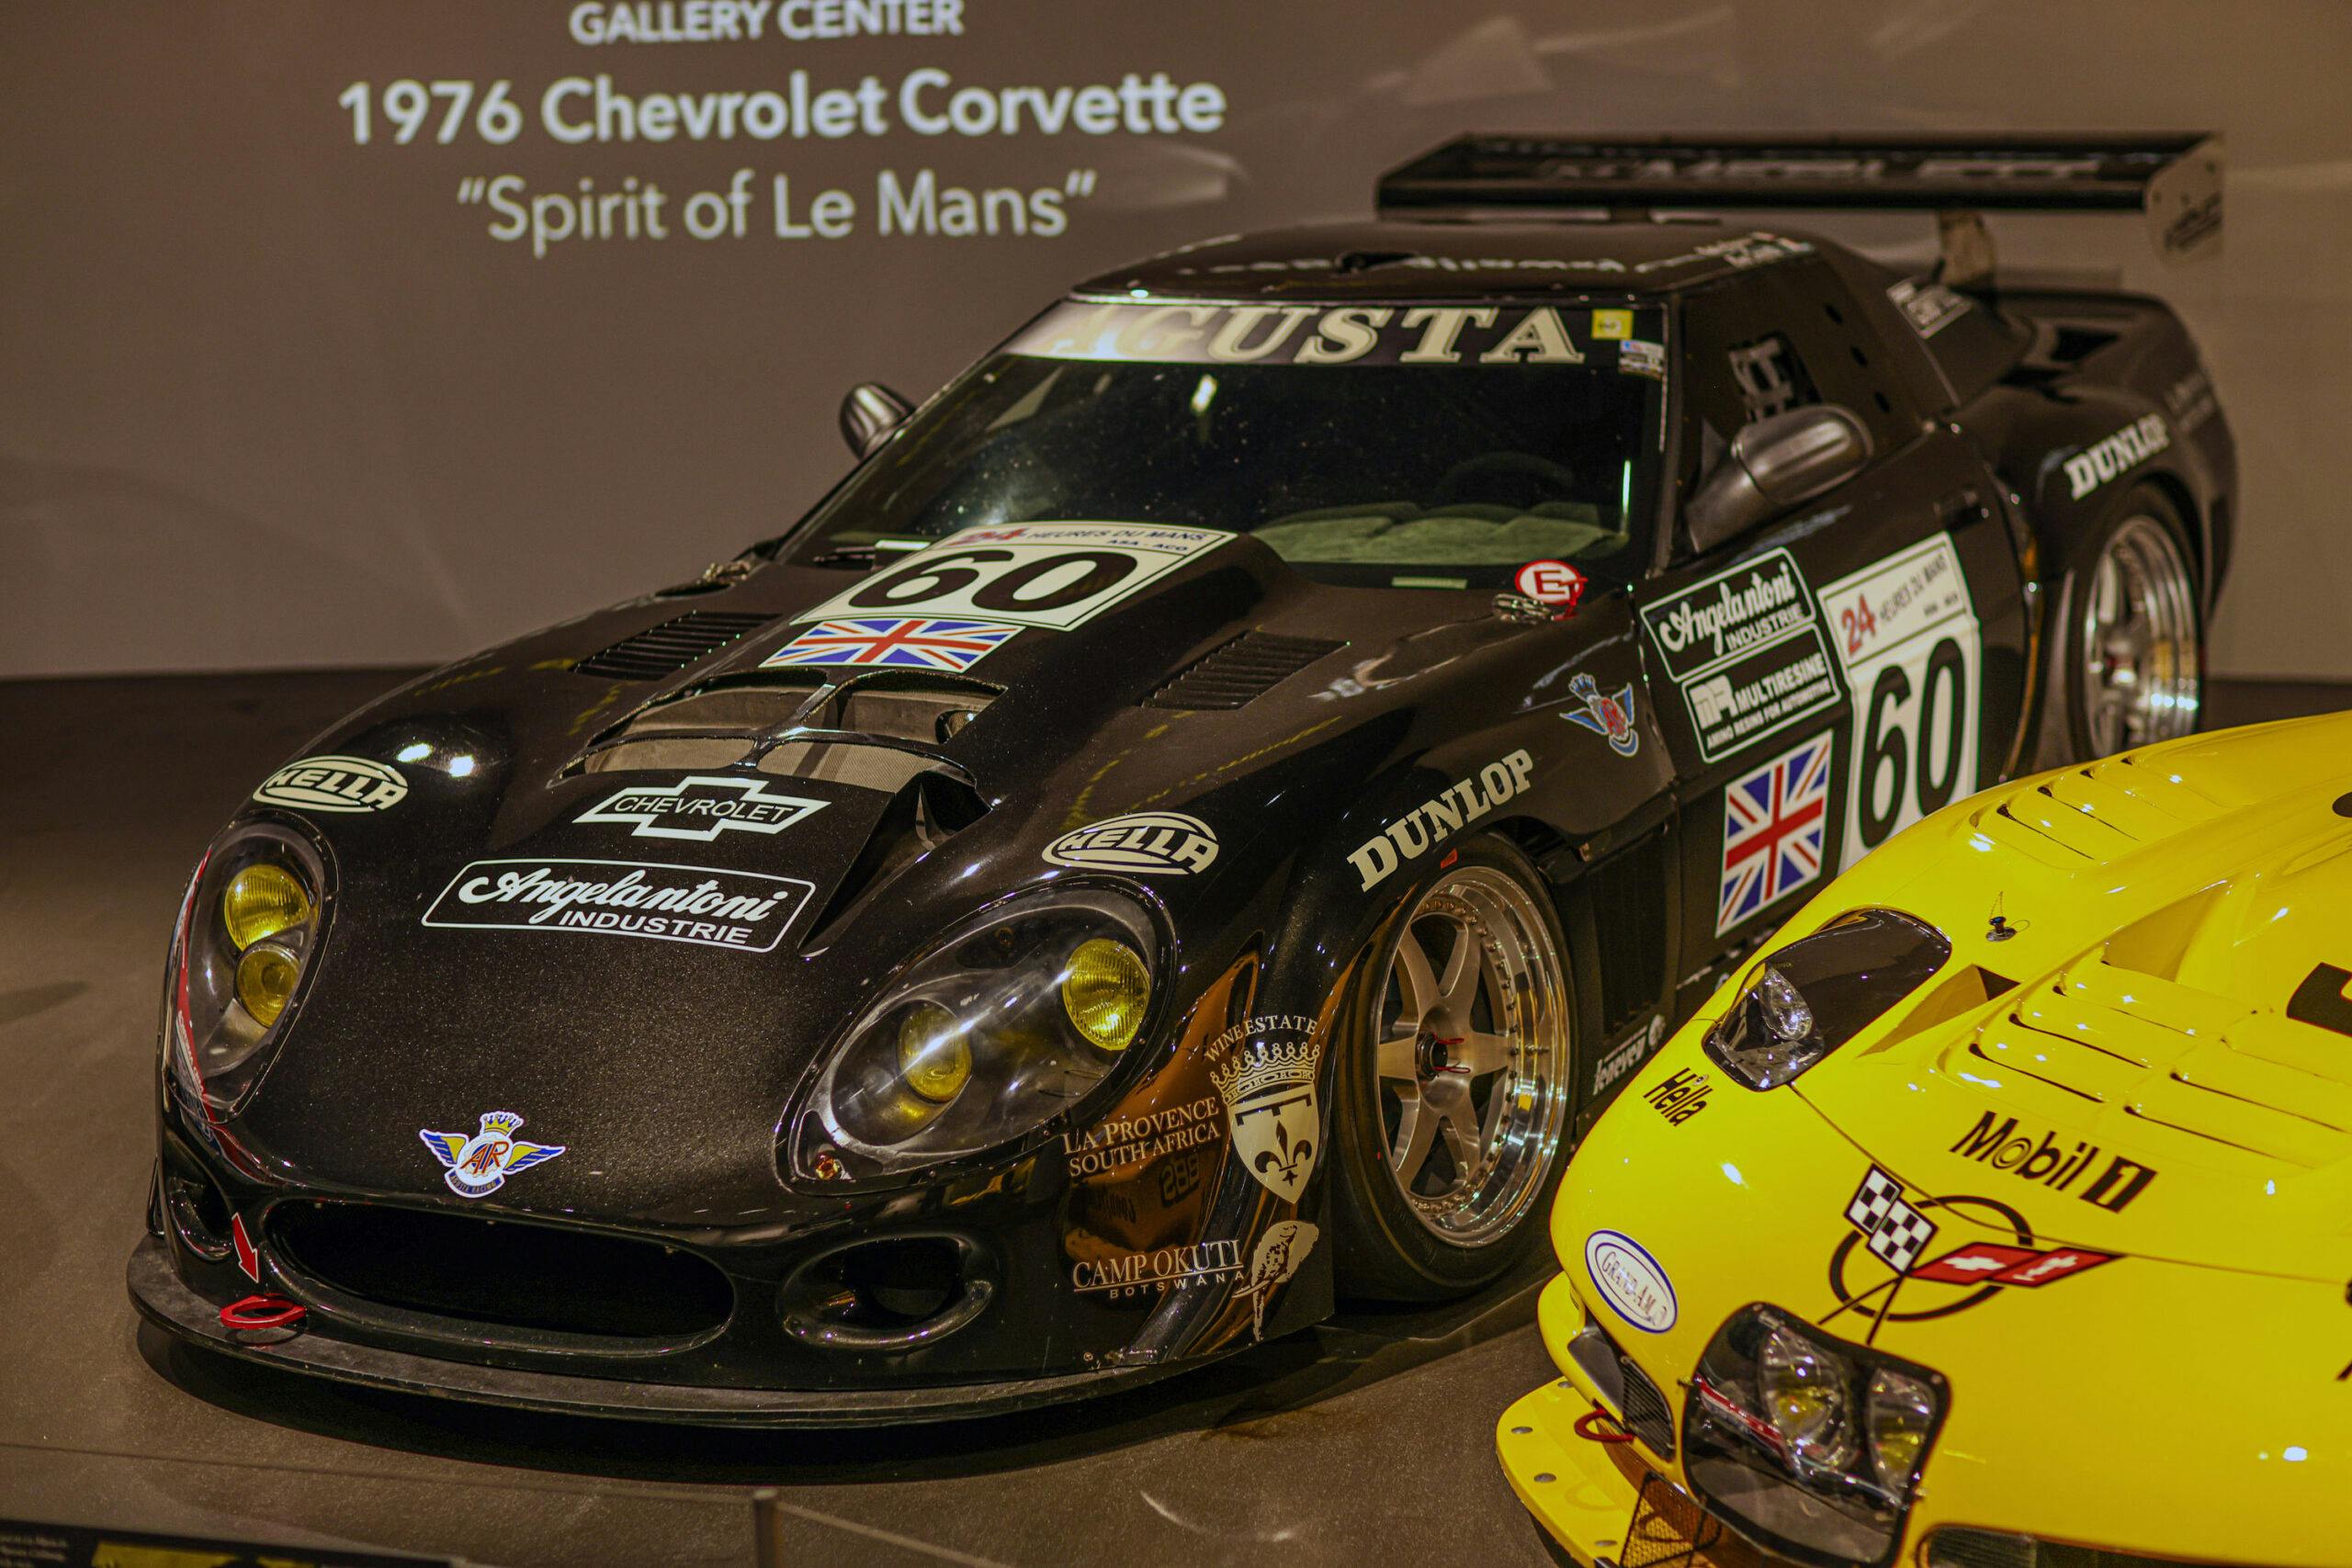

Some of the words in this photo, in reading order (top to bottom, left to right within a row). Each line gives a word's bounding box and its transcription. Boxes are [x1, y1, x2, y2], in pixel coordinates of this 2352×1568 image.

[569, 1, 771, 45] GALLERY
[777, 0, 965, 39] CENTER
[338, 79, 523, 145] 1976
[540, 70, 888, 143] Chevrolet
[899, 68, 1227, 136] Corvette
[684, 169, 753, 239] of
[774, 175, 854, 239] Le
[1038, 305, 1586, 364] AGUSTA
[1025, 529, 1108, 539] HEURES
[1113, 530, 1147, 538] DU
[1146, 531, 1207, 542] MANS
[848, 548, 1138, 613] 60
[1659, 561, 1797, 658] Angelantoni
[1724, 602, 1805, 652] INDUSTRIE
[1840, 593, 1878, 657] 24
[1735, 651, 1828, 715] MULTIRESINE
[1859, 637, 1966, 851] 60
[267, 767, 409, 812] HELLA
[613, 795, 793, 826] CHEVROLET
[1057, 825, 1220, 874] HELLA
[1346, 749, 1534, 893] DUNLOP
[458, 867, 790, 925] Angelantoni
[559, 909, 753, 946] INDUSTRIE
[1062, 1131, 1098, 1156] LA
[1102, 1096, 1220, 1145] PROVENCE
[1642, 1066, 1713, 1128] Hella
[460, 1142, 510, 1176] AR
[1069, 1141, 1148, 1178] SOUTH
[1151, 1121, 1222, 1157] AFRICA
[1948, 1110, 2101, 1192] Mobil
[2086, 1159, 2152, 1211] 1
[1072, 1253, 1148, 1290] CAMP
[1153, 1239, 1243, 1278] OKUTI
[1109, 1270, 1246, 1300] BOTSWANA
